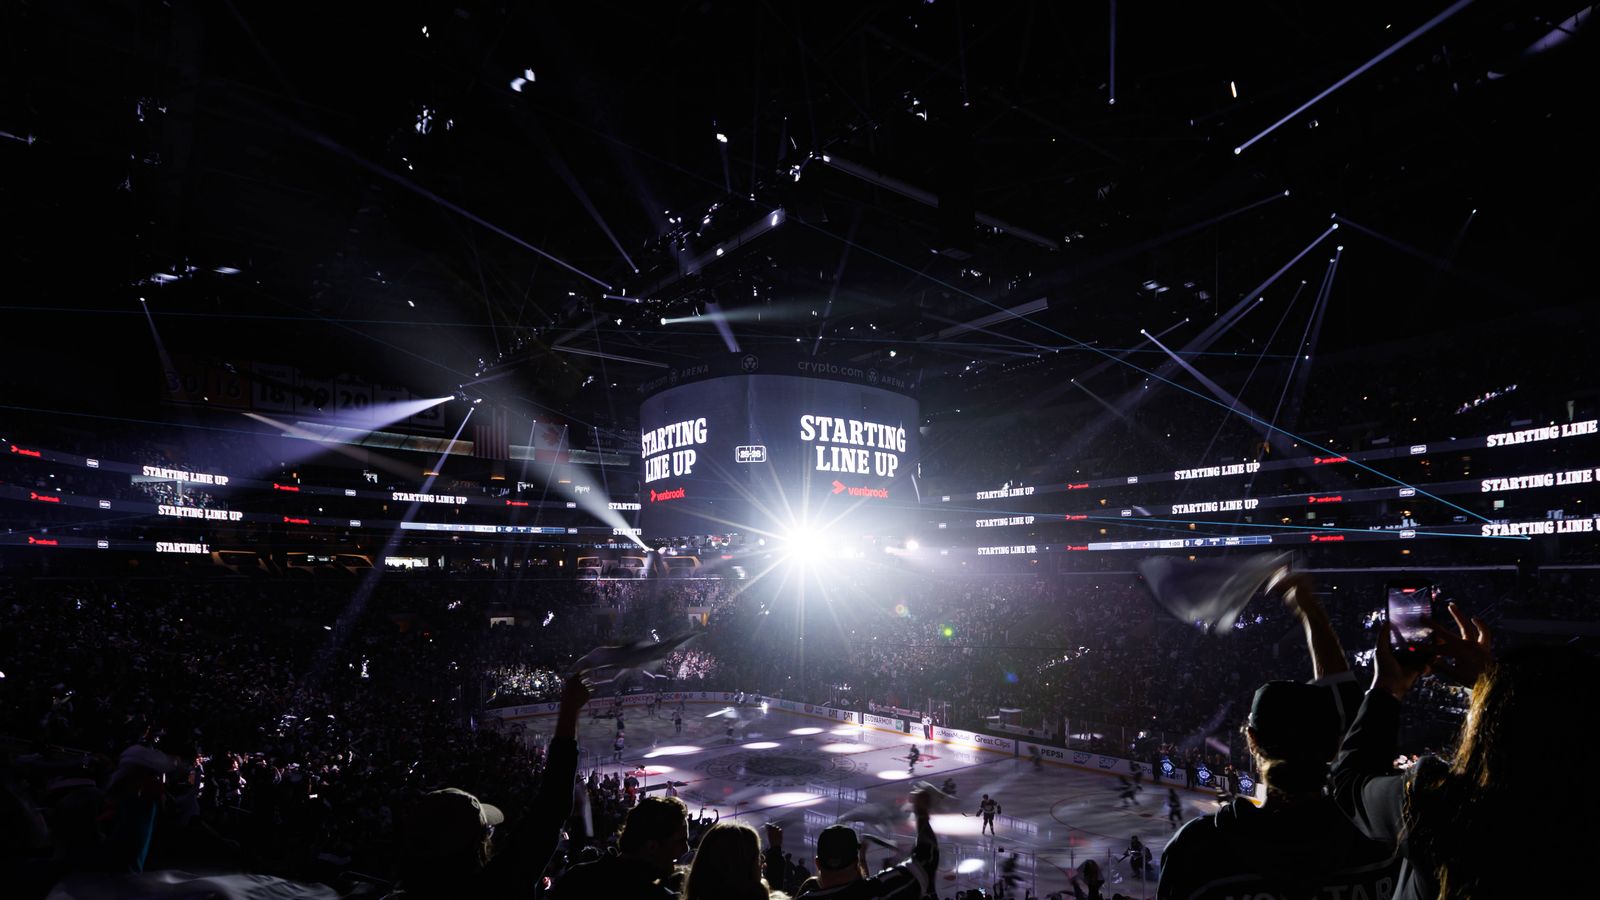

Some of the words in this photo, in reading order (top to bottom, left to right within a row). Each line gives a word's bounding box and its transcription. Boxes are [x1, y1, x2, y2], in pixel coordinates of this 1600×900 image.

[682, 364, 709, 378] ARENA
[798, 361, 864, 378] crypto.com
[882, 376, 905, 388] ARENA
[642, 417, 708, 458] STARTING
[800, 414, 906, 452] STARTING
[1487, 426, 1560, 448] STARTING
[1562, 420, 1598, 438] LINE
[645, 453, 670, 484] LINE
[672, 449, 696, 476] UP
[816, 446, 870, 474] LINE
[874, 451, 898, 478] UP
[143, 466, 189, 481] STARTING
[190, 472, 213, 484] LINE
[214, 475, 229, 486] UP
[1174, 468, 1220, 481] STARTING
[1221, 464, 1245, 476] LINE
[1246, 462, 1261, 473] UP
[1482, 474, 1554, 492] STARTING
[1556, 469, 1592, 485] LINE
[392, 492, 434, 503] STARTING
[436, 495, 455, 504] LINE
[456, 496, 467, 505] UP
[656, 488, 686, 501] venbrook
[848, 486, 888, 498] venbrook
[976, 490, 1008, 500] STARTING
[1009, 488, 1024, 497] LINE
[1025, 486, 1035, 496] UP
[158, 505, 203, 518] STARTING
[205, 509, 228, 520] LINE
[229, 511, 243, 521] UP
[1172, 502, 1218, 515] STARTING
[1220, 500, 1244, 511] LINE
[1245, 499, 1259, 510] UP
[976, 518, 1008, 528] STARTING
[1009, 517, 1024, 526] LINE
[1025, 516, 1035, 525] UP
[1482, 521, 1554, 537] STARTING
[1557, 519, 1593, 533] LINE
[156, 542, 202, 554] STARTING
[978, 546, 1009, 555] STARTING
[1010, 546, 1025, 554] LINE
[975, 734, 994, 744] Great
[995, 738, 1011, 749] Clips
[1041, 748, 1064, 759] PEPSI
